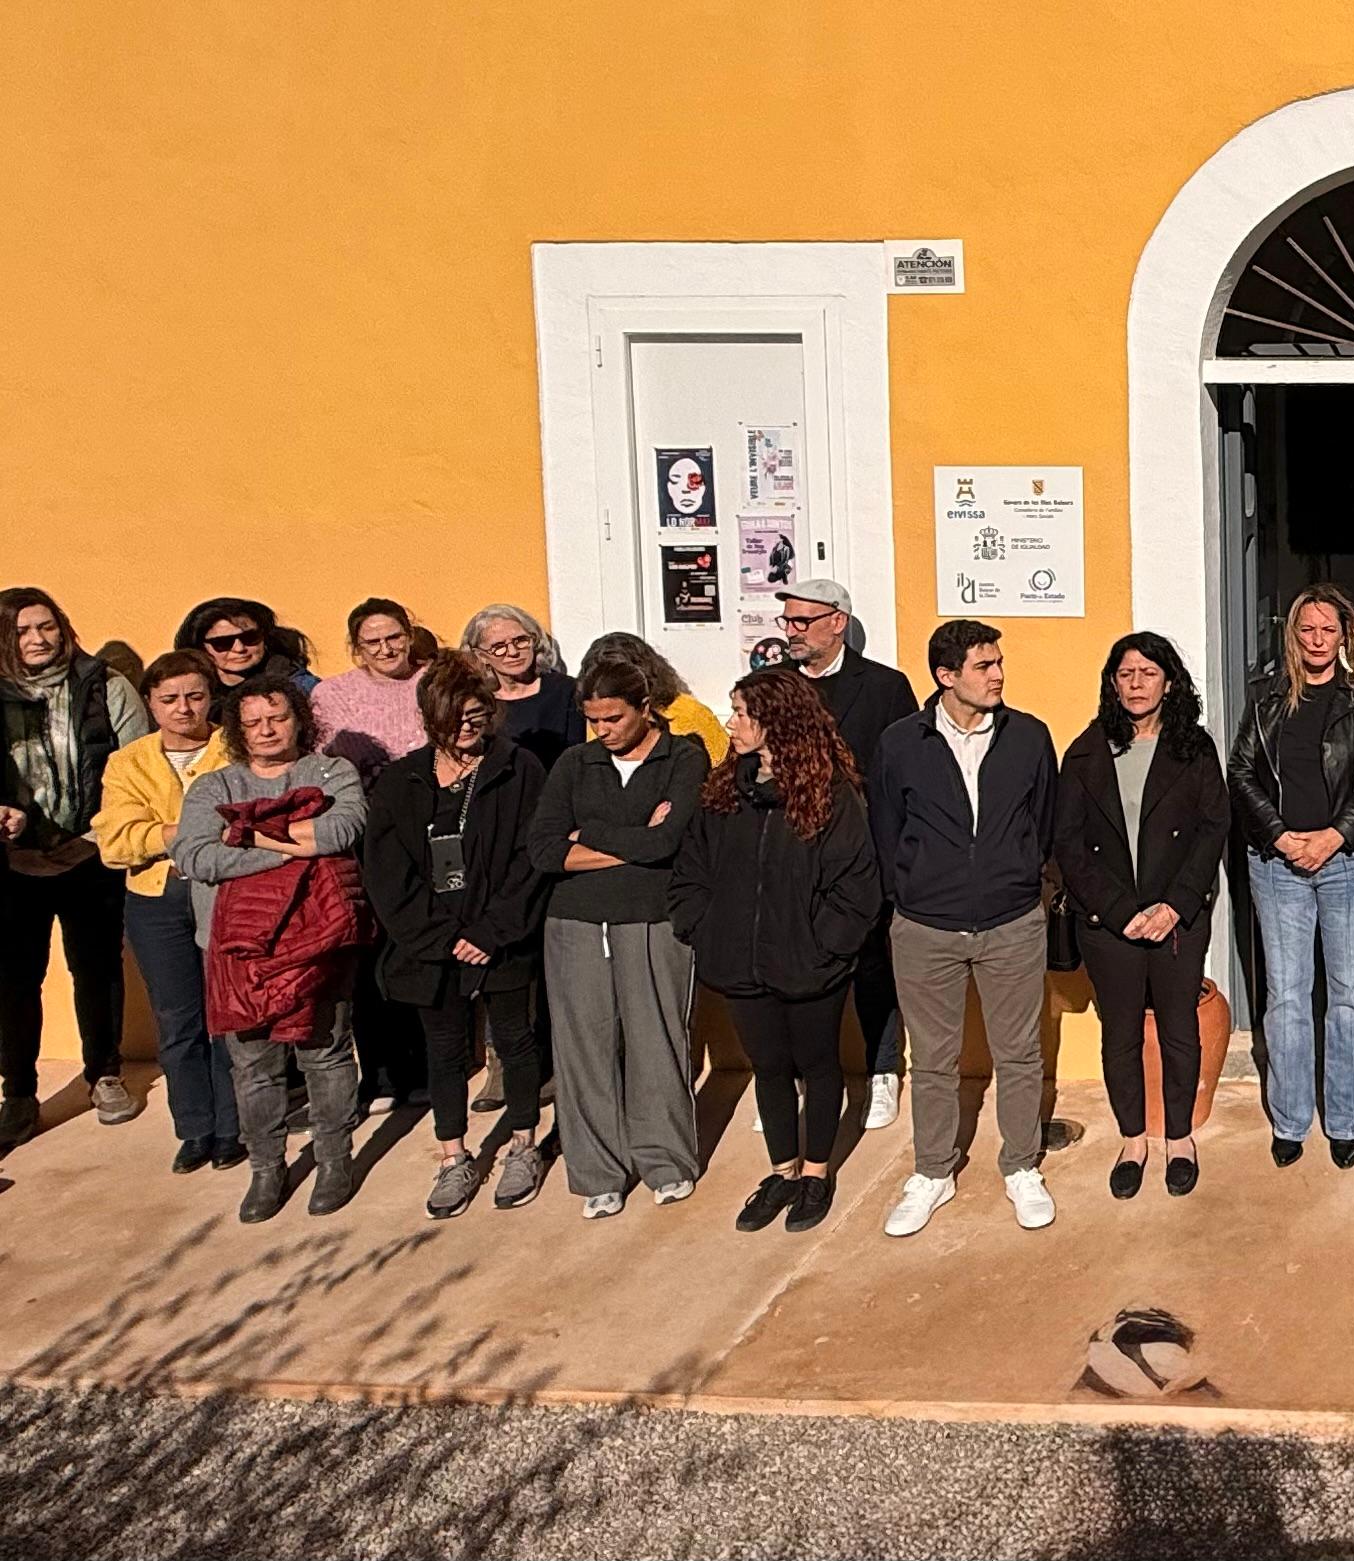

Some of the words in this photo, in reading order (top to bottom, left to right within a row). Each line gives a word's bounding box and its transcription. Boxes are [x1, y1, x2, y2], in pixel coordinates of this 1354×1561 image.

[897, 259, 952, 268] ATENCIÓN
[947, 510, 986, 519] eivissa
[741, 614, 764, 623] Club
